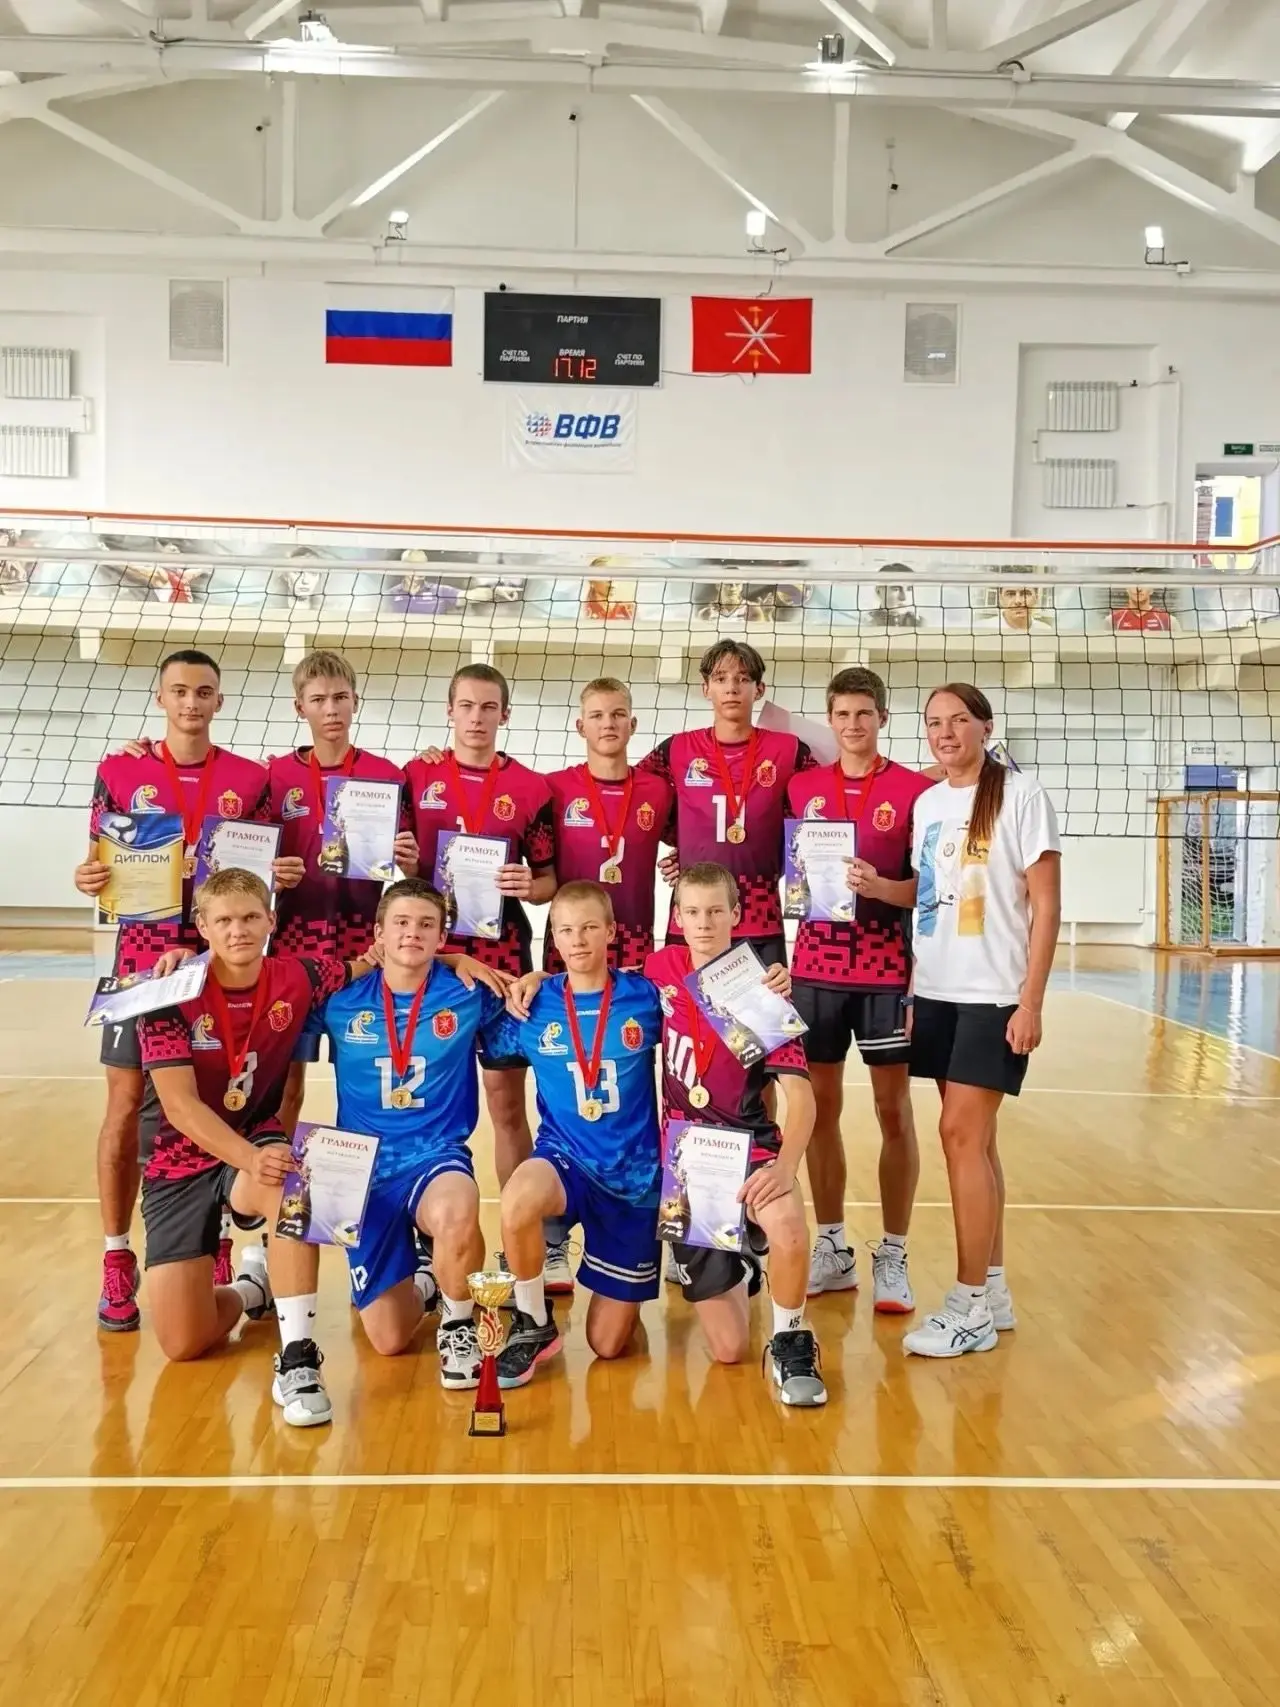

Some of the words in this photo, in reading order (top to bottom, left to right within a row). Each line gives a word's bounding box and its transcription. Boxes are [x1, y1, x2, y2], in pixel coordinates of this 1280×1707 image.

[557, 315, 589, 324] ПАРТИЯ
[559, 349, 586, 357] ВРЕМЯ
[553, 414, 621, 439] ВФВ
[350, 790, 392, 800] ГРАМОТА
[227, 830, 272, 844] ГРАМОТА
[807, 830, 849, 839] ГРАМОТА
[459, 844, 500, 857] ГРАМОТА
[114, 854, 170, 864] ДИПЛОМ
[709, 954, 749, 983] ГРАМОТА
[113, 1025, 123, 1049] 7
[374, 1055, 427, 1110] 12
[566, 1059, 620, 1117] 13
[320, 1136, 369, 1152] ГРАМОТА
[693, 1136, 741, 1151] ГРАМОТА
